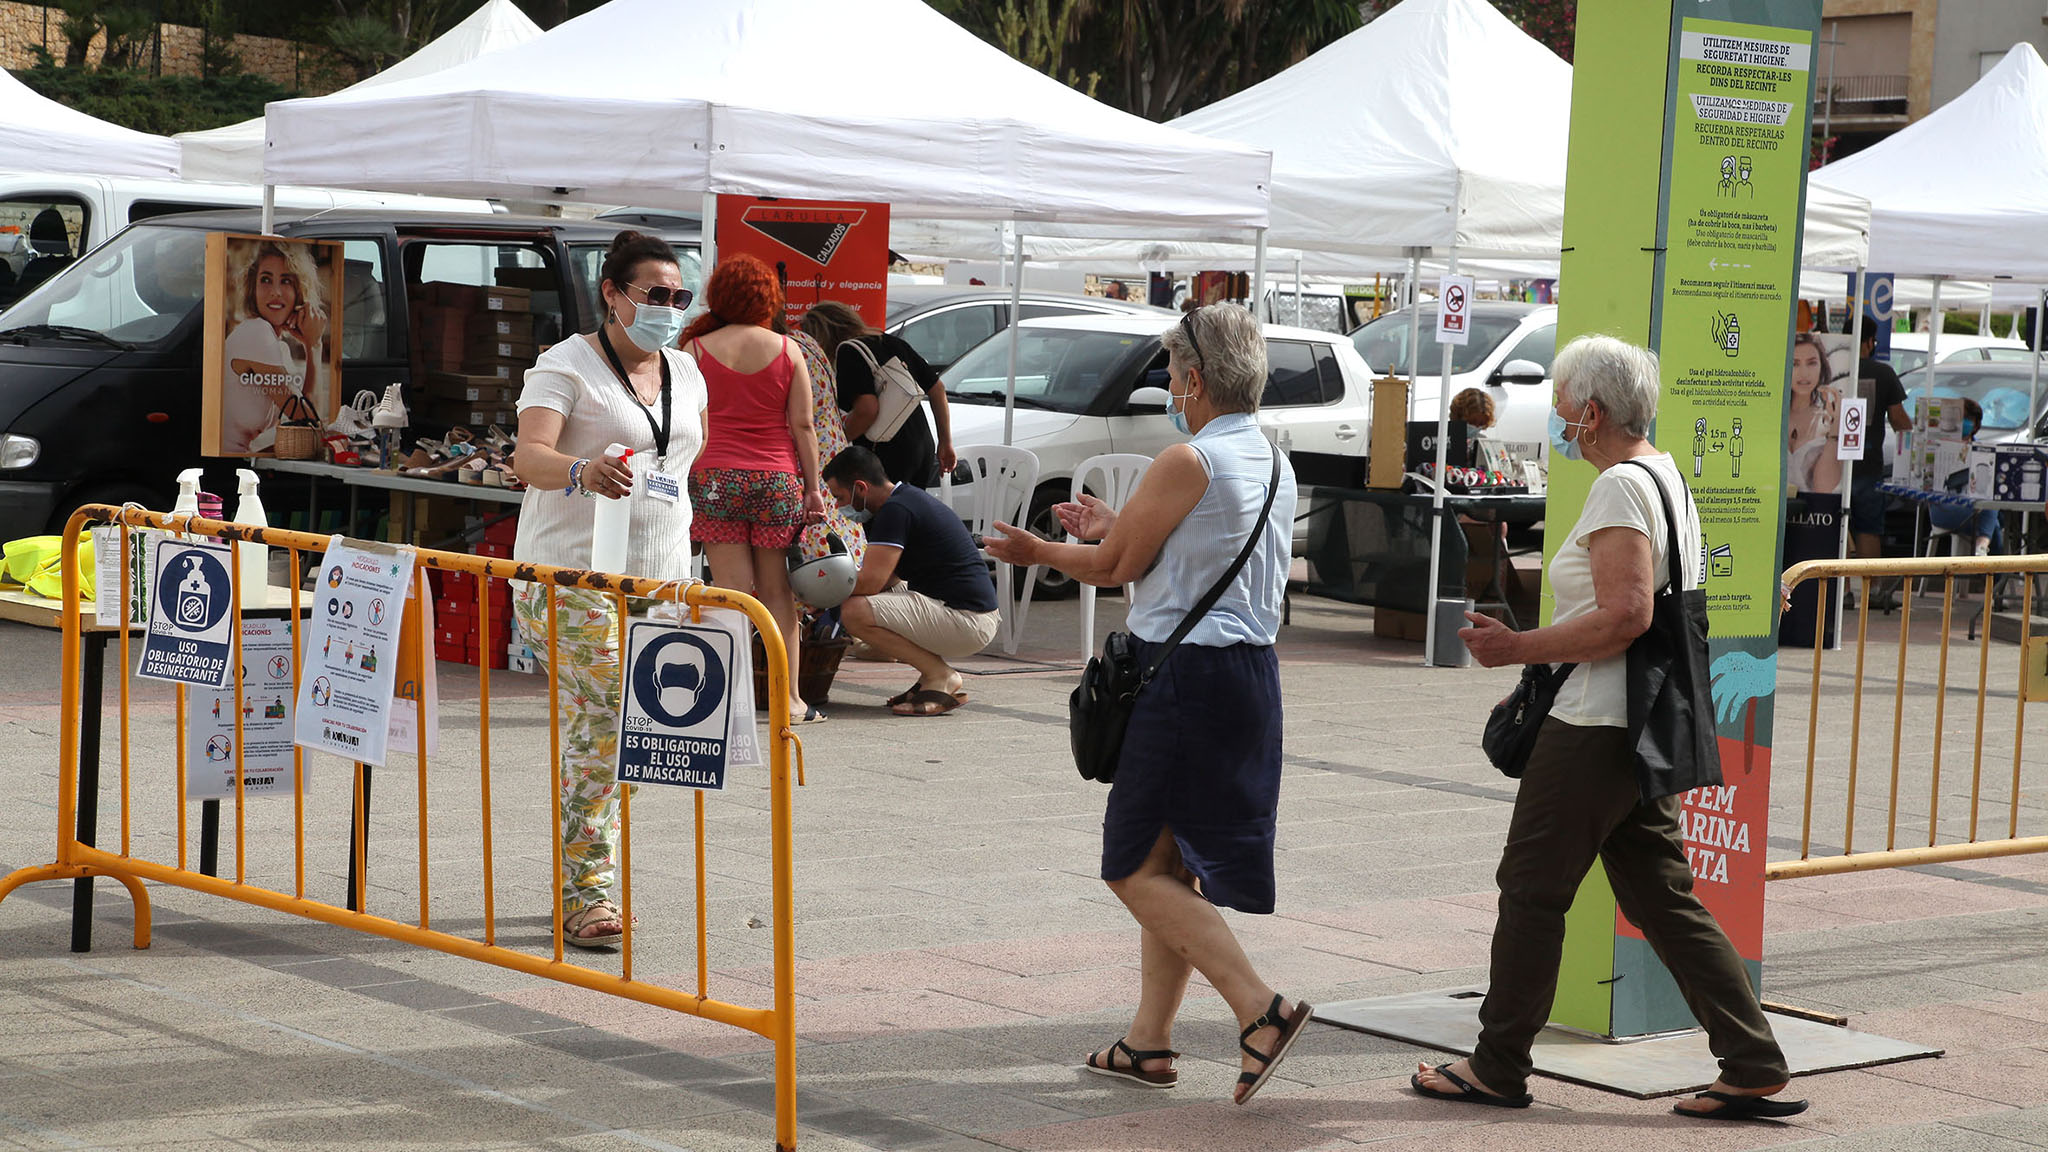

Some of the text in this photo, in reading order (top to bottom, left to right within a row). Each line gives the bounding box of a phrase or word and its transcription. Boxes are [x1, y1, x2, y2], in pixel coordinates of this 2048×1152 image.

[1703, 37, 1790, 55] UTILITZEM MESURES DE
[1704, 50, 1787, 66] SEGURETAT I HIGIENE.
[1697, 64, 1791, 82] RECORDA RESPECTAR-LES
[1710, 78, 1776, 92] DINS DEL RECINTE
[1697, 96, 1787, 113] UTILIZAMOS MEDIDAS DE
[1699, 109, 1782, 124] SEGURIDAD E HIGIENE.
[1695, 123, 1784, 139] RECUERDA RESPETARLAS
[1700, 135, 1778, 150] DENTRO DEL RECINTO
[760, 211, 844, 220] LARULLA
[1708, 210, 1733, 219] obligatori
[1755, 224, 1777, 232] barbeta)
[817, 224, 846, 262] CALZADOS
[840, 281, 882, 290] elegancia
[1680, 279, 1712, 287] Recomanem
[1713, 280, 1729, 289] seguir
[1673, 288, 1712, 296] Recomendamos
[1713, 290, 1728, 299] seguir
[1735, 290, 1759, 299] itinerario
[240, 372, 302, 386] GIOSEPPO
[254, 388, 291, 396] WOMAN
[1686, 388, 1694, 397] gel
[1738, 389, 1771, 397] desinfectante
[1711, 430, 1719, 438] 1,5
[153, 622, 174, 630] STOP
[179, 642, 198, 653] USO
[148, 650, 224, 670] OBLIGATORIO DE
[147, 664, 218, 682] DESINFECTANTE
[627, 716, 652, 726] STOP
[626, 736, 720, 756] ES OBLIGATORIO
[651, 752, 690, 767] EL USO
[625, 764, 716, 784] DE MASCARILLA
[1679, 810, 1750, 853] ARINA
[1688, 847, 1728, 884] LTA
